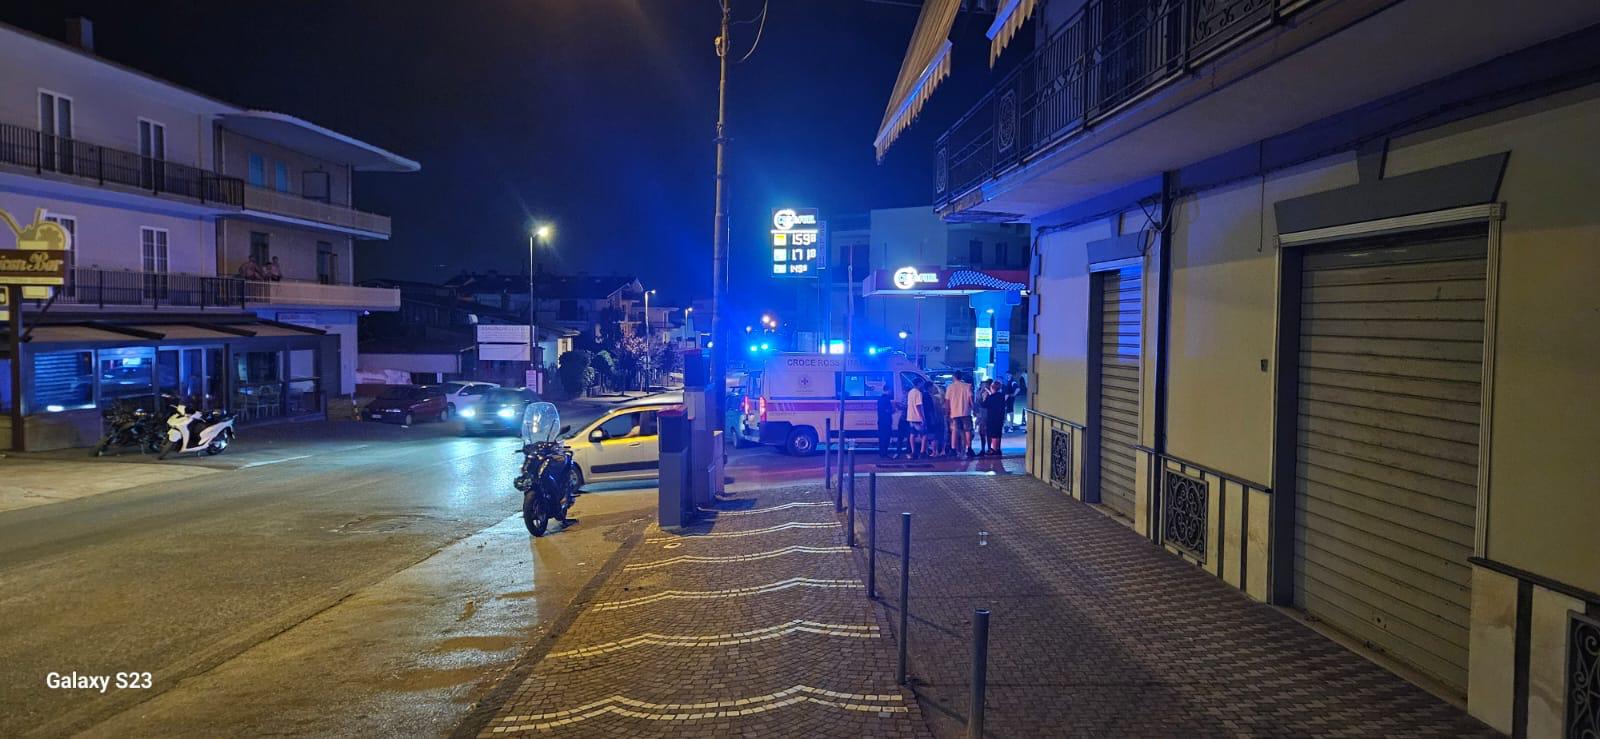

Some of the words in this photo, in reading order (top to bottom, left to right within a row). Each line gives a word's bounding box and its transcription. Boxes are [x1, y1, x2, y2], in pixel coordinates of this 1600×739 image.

[27, 251, 64, 272] Bar
[787, 358, 816, 367] CROCE
[818, 358, 845, 367] ROSS
